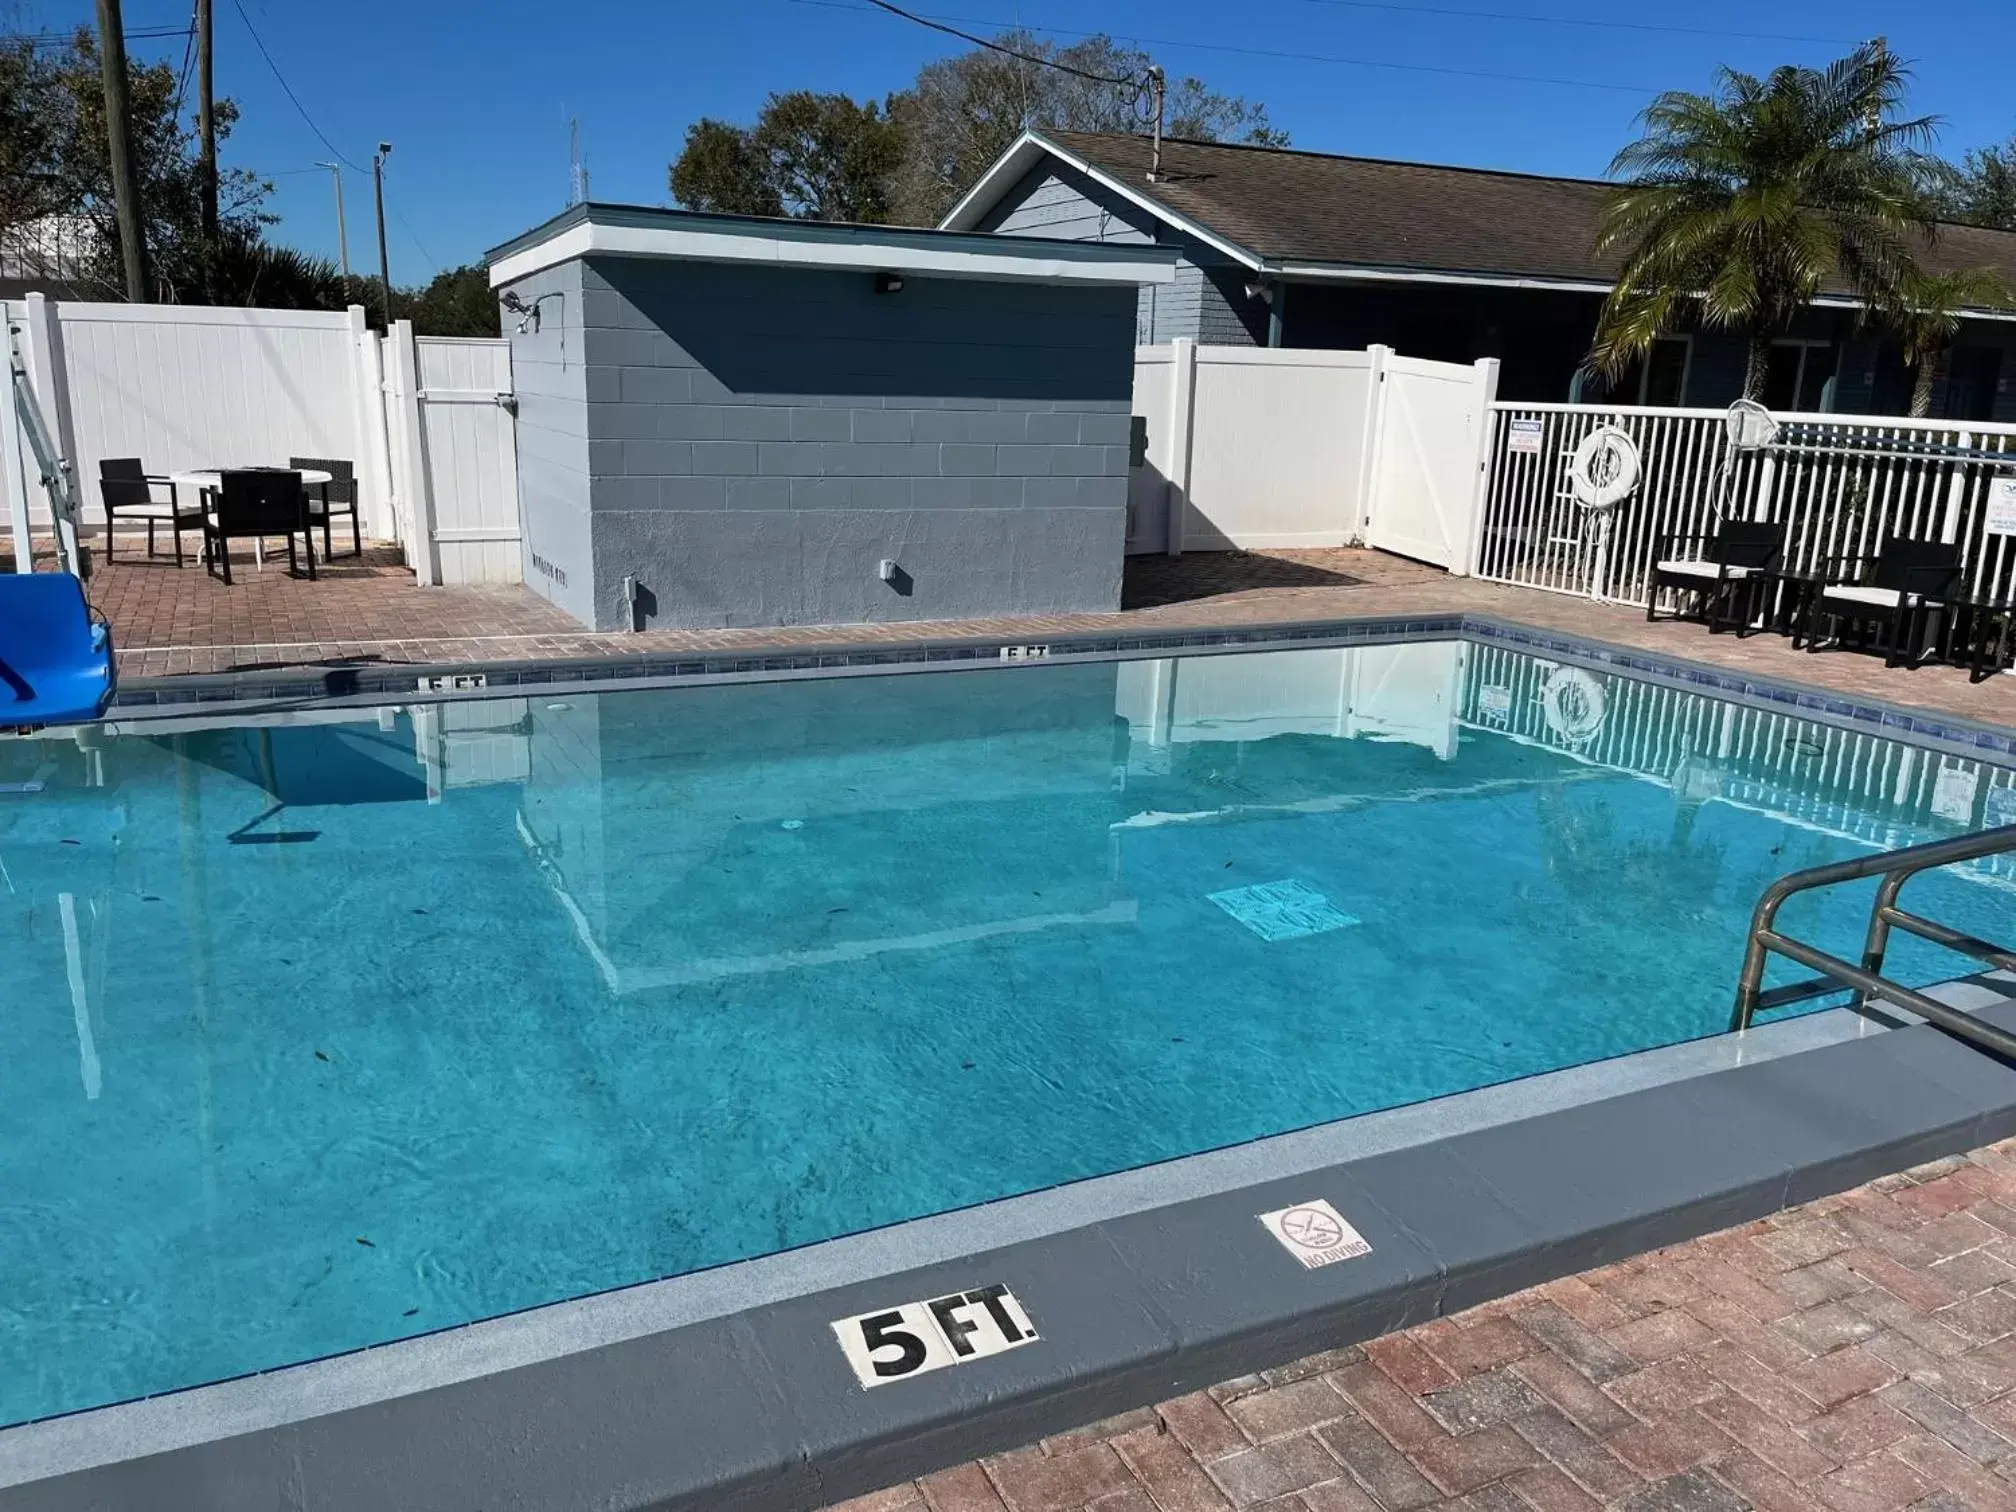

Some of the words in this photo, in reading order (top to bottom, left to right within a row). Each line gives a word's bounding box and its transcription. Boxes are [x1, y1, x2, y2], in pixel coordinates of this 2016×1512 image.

[1303, 1253, 1326, 1269] NO
[1322, 1240, 1369, 1262] DIVING
[859, 1310, 927, 1377] 5
